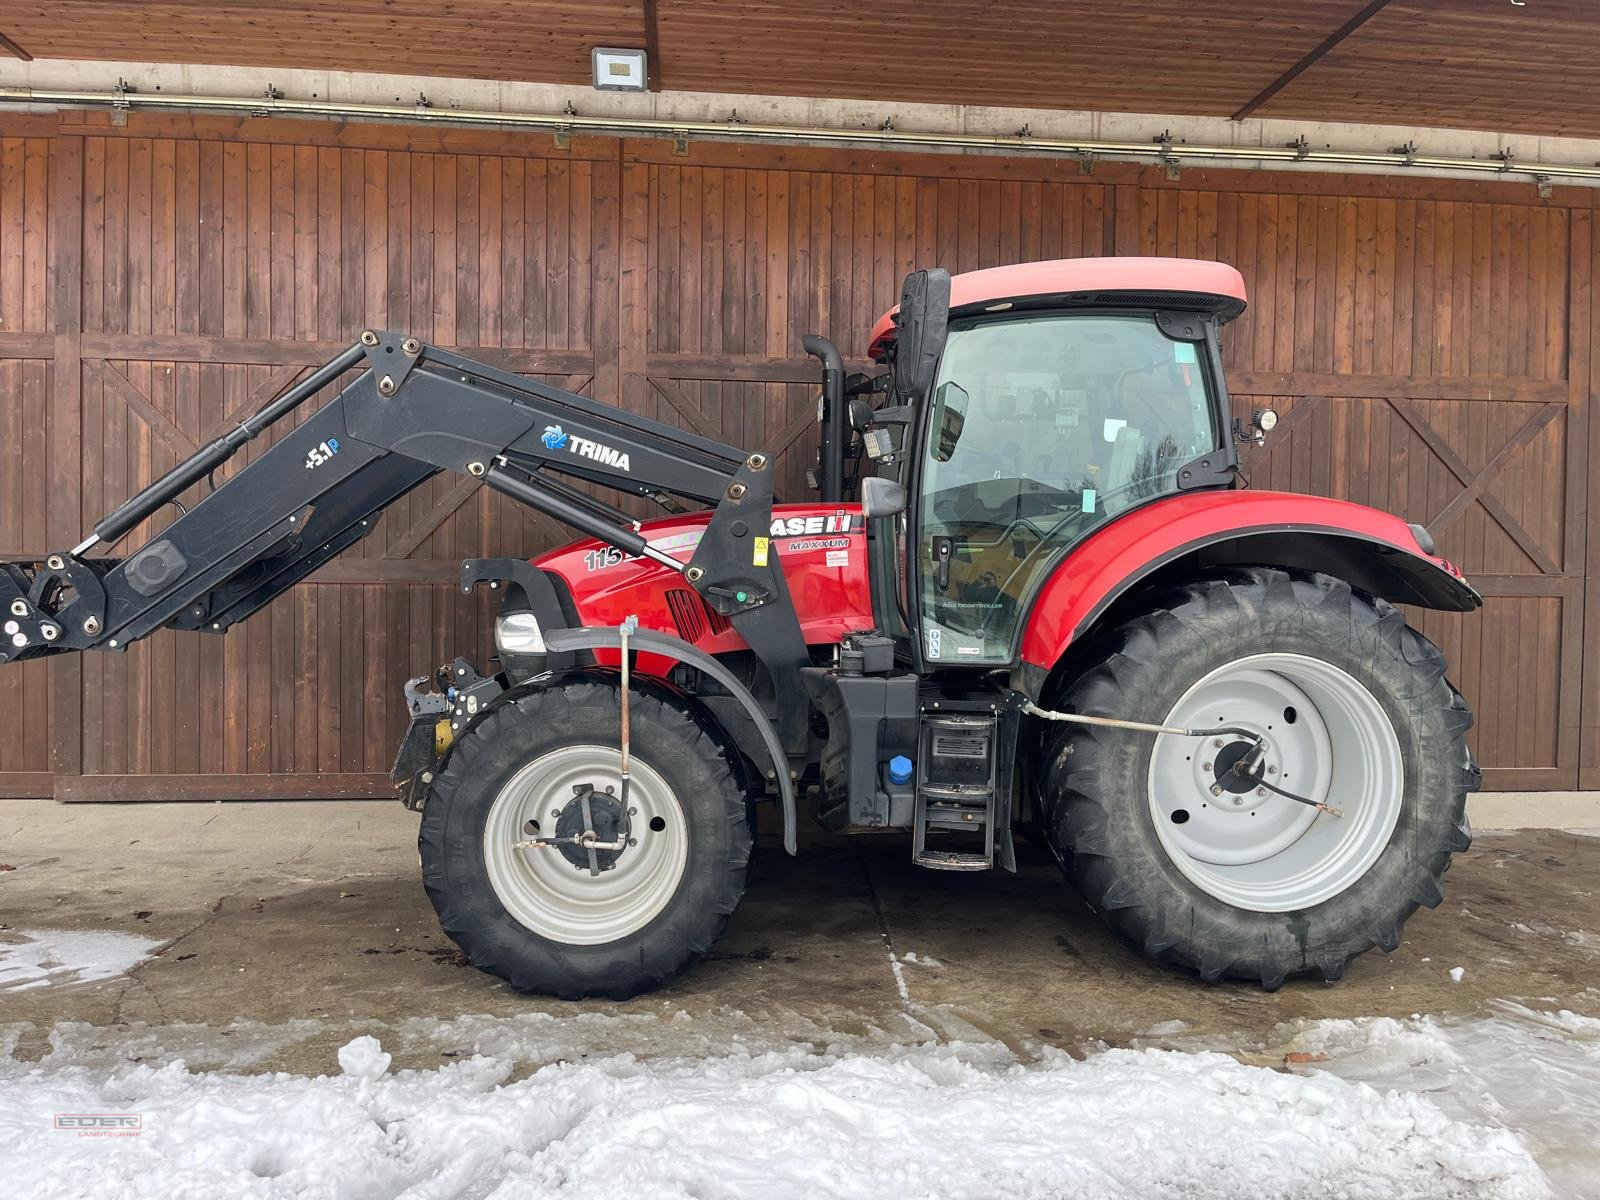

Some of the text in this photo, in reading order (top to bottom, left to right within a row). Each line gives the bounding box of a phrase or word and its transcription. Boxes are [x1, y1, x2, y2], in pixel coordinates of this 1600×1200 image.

[569, 434, 630, 472] TRIMA
[769, 517, 825, 537] ASE
[789, 538, 850, 552] MAXXUM
[584, 545, 623, 572] 115
